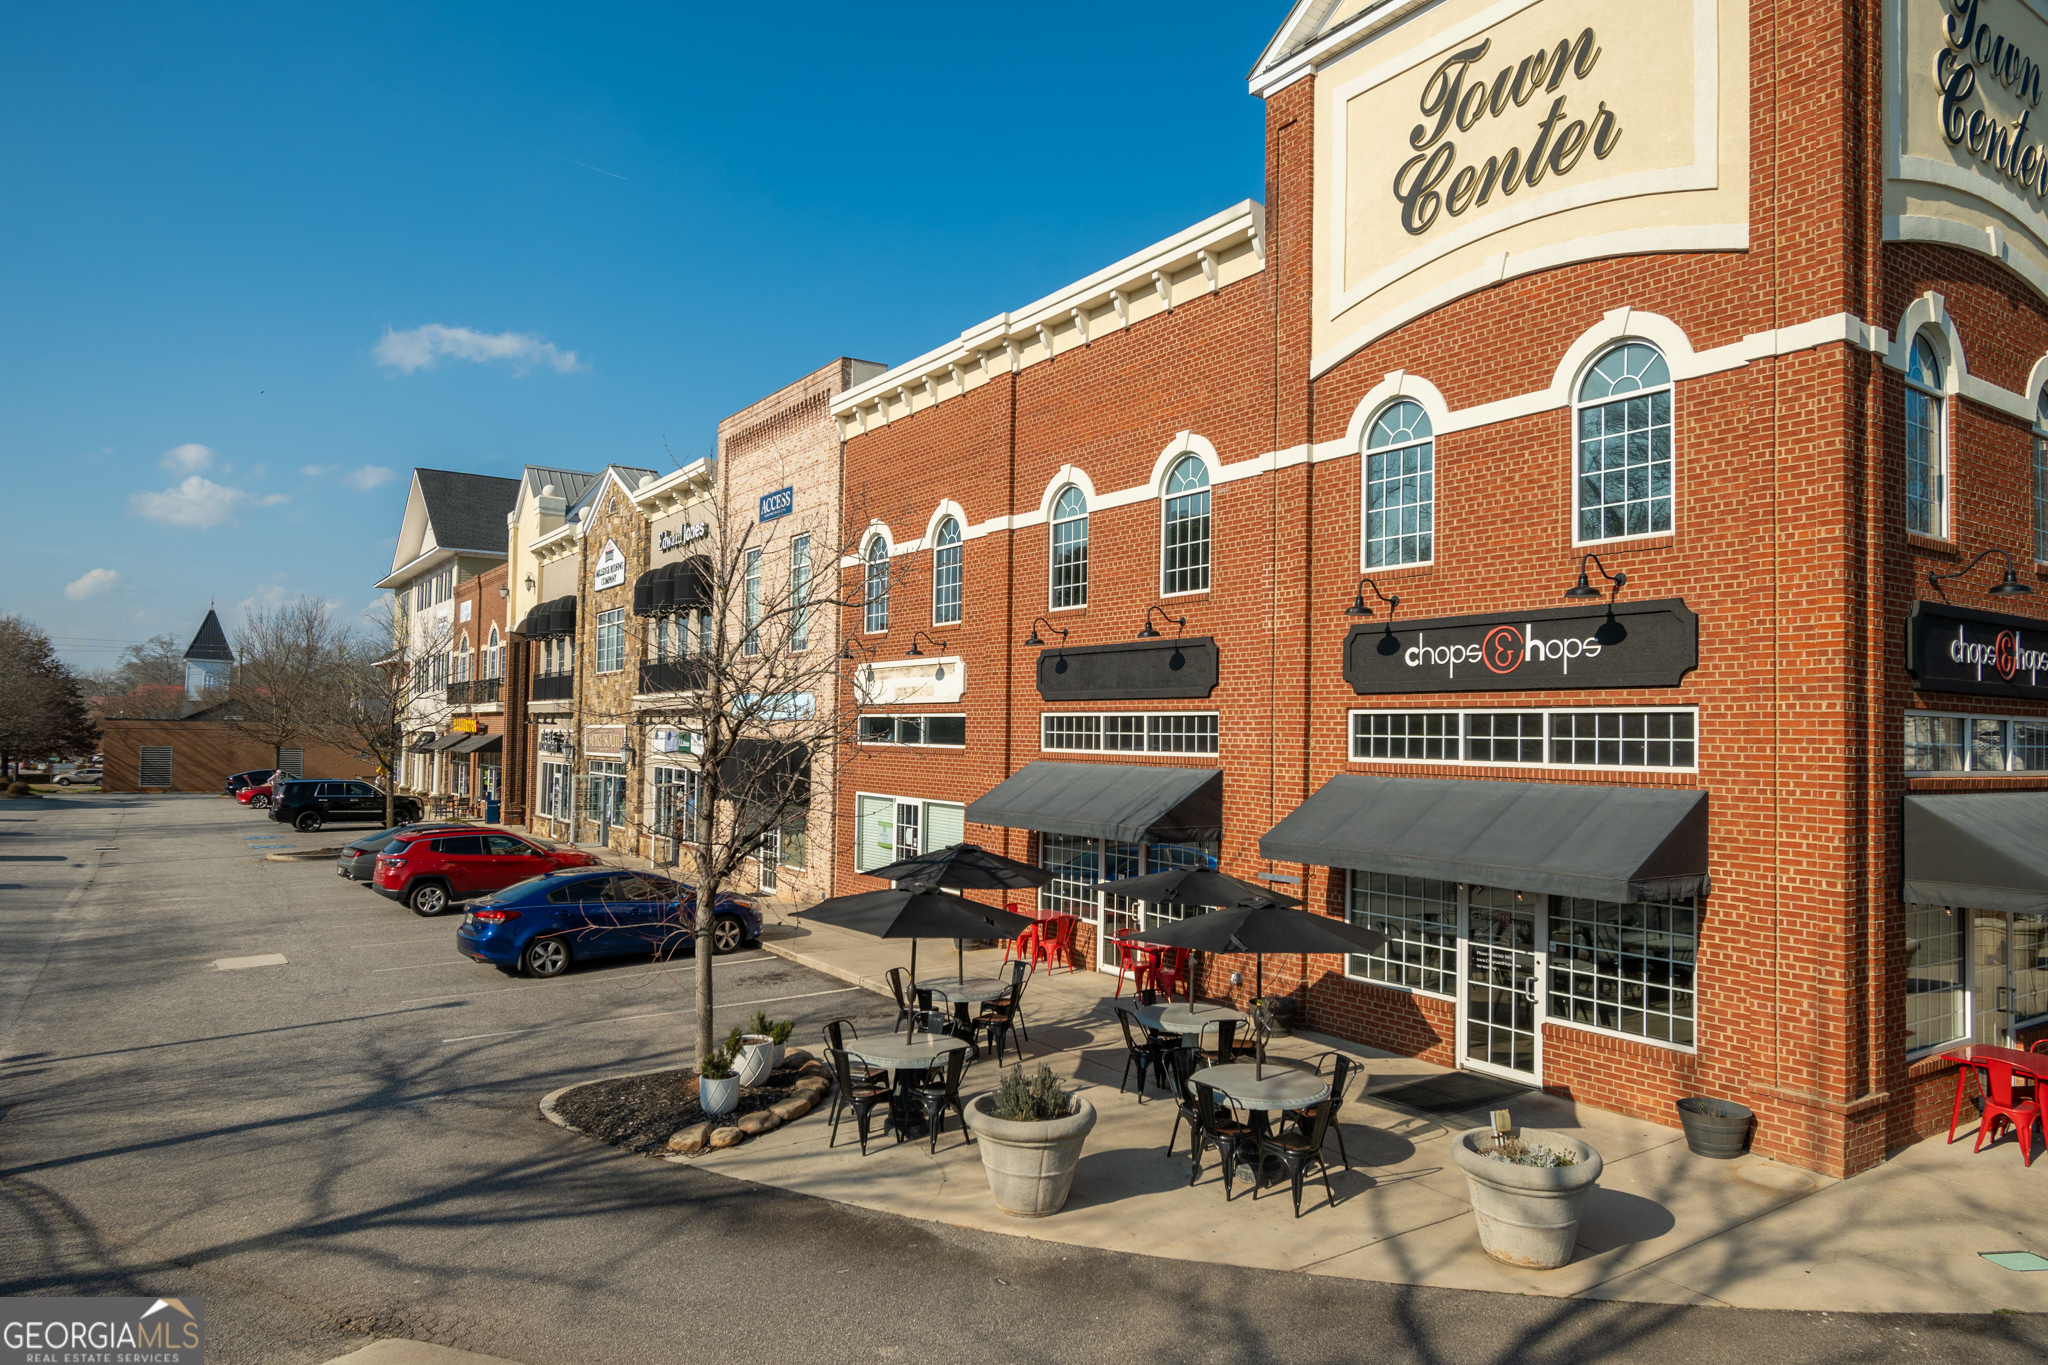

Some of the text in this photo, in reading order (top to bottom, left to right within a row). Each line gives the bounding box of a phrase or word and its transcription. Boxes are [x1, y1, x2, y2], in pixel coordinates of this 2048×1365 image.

[1409, 26, 1603, 152] Town
[1393, 94, 1624, 236] Center
[760, 490, 791, 515] ACCESS
[657, 521, 706, 552] Edward Jones
[601, 573, 617, 586] COMPANY
[1404, 632, 1483, 679] chops
[1524, 623, 1603, 675] hops
[1950, 624, 1996, 682] chops
